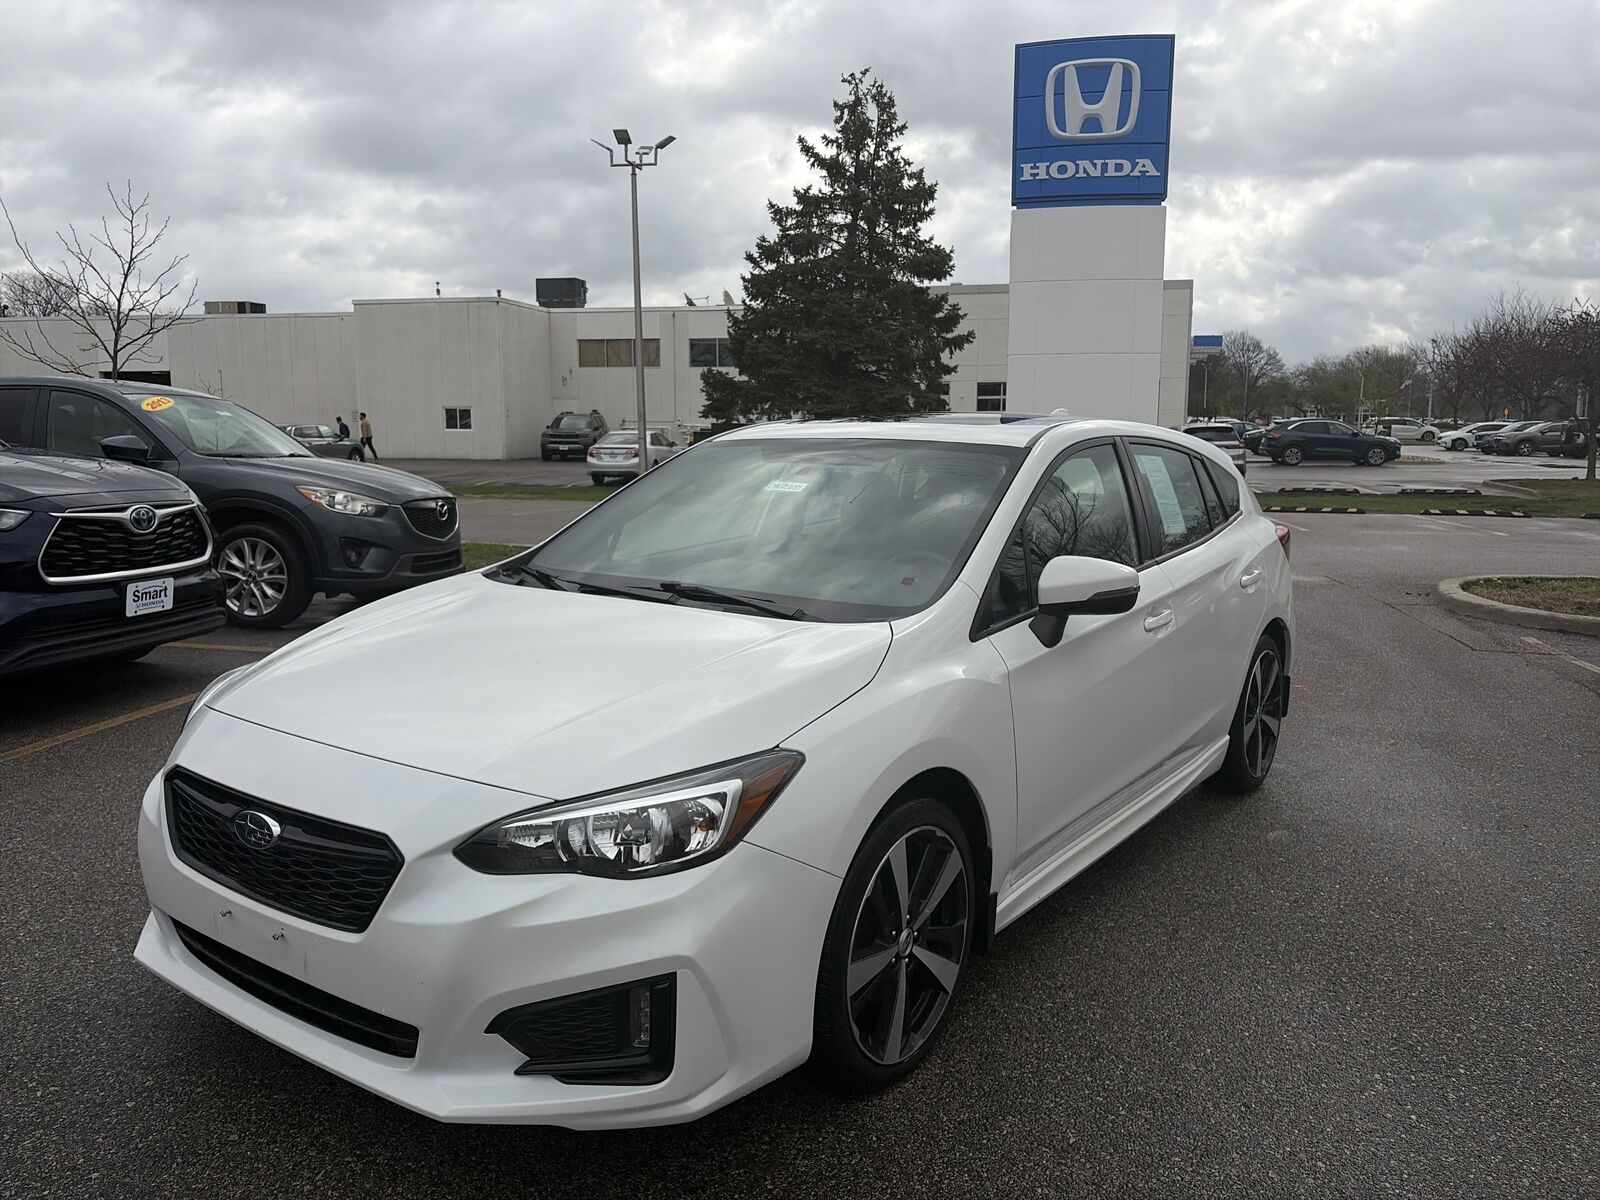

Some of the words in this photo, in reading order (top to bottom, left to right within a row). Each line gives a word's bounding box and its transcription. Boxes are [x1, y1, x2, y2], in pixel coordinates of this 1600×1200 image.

[1020, 158, 1160, 181] HONDA
[145, 397, 172, 410] 2013
[132, 585, 168, 603] Smart
[141, 599, 165, 608] HONDA
